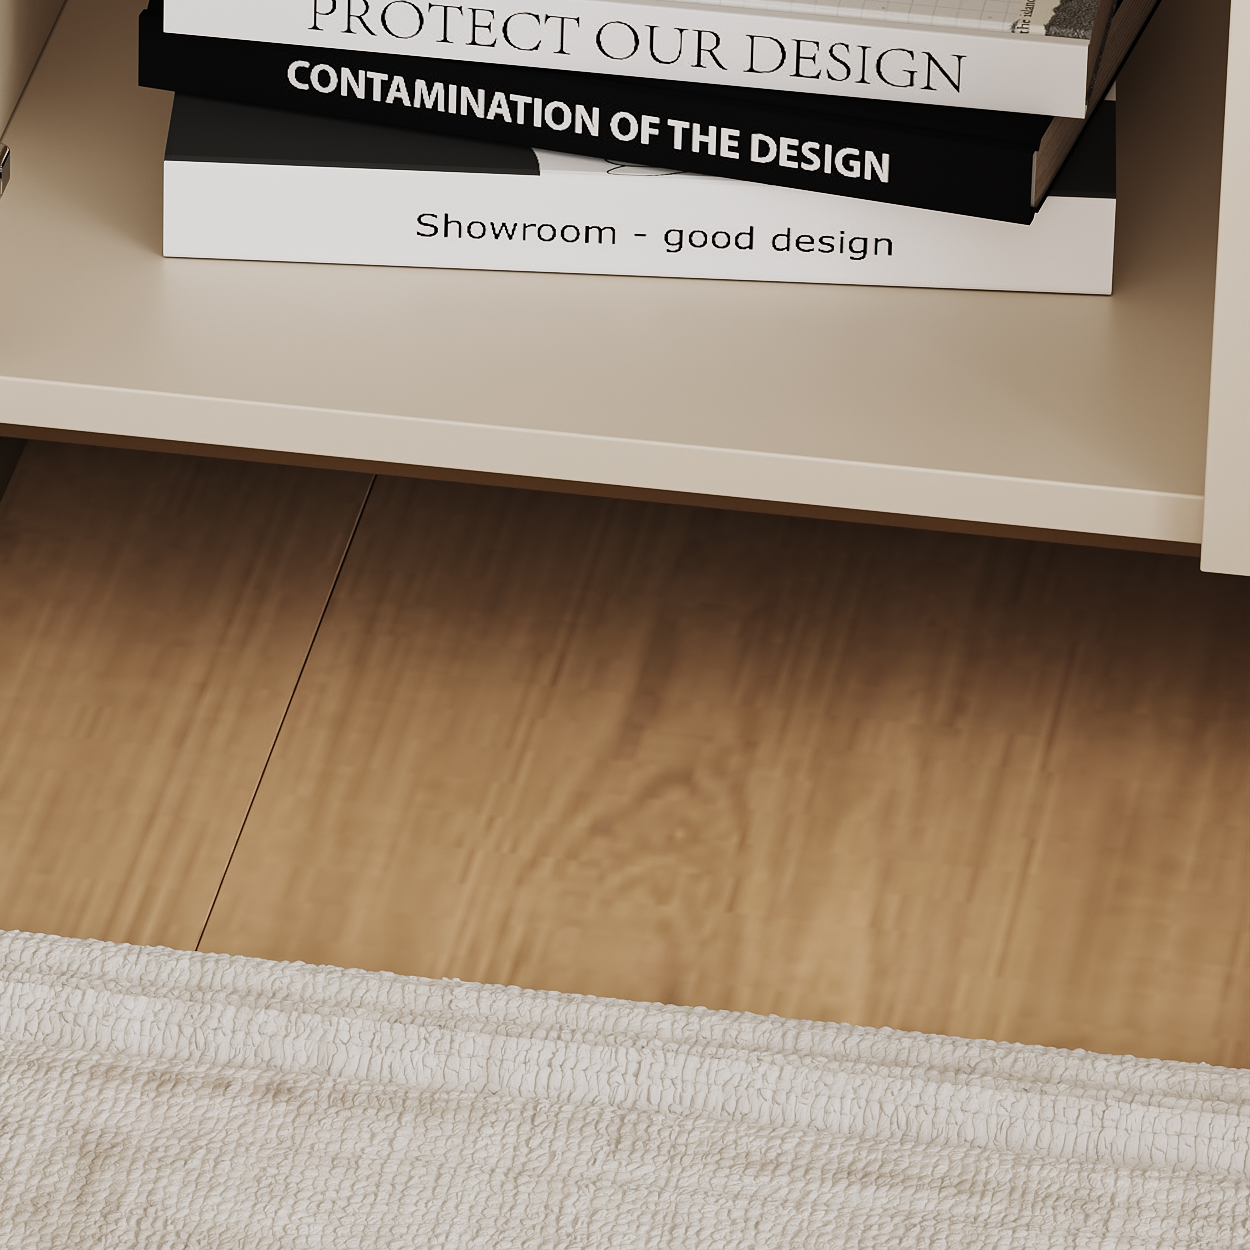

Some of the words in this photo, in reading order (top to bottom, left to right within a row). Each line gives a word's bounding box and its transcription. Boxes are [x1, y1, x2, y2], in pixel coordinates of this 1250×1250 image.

[595, 20, 728, 71] OUR
[743, 33, 967, 93] DESIGN
[1016, 19, 1031, 34] the
[286, 59, 600, 138] CONTAMINATION
[609, 110, 661, 146] OF
[667, 118, 741, 160] THE
[750, 132, 891, 184] DESIGN
[416, 212, 617, 246] Showroom
[663, 225, 755, 253] good
[771, 227, 894, 261] design
